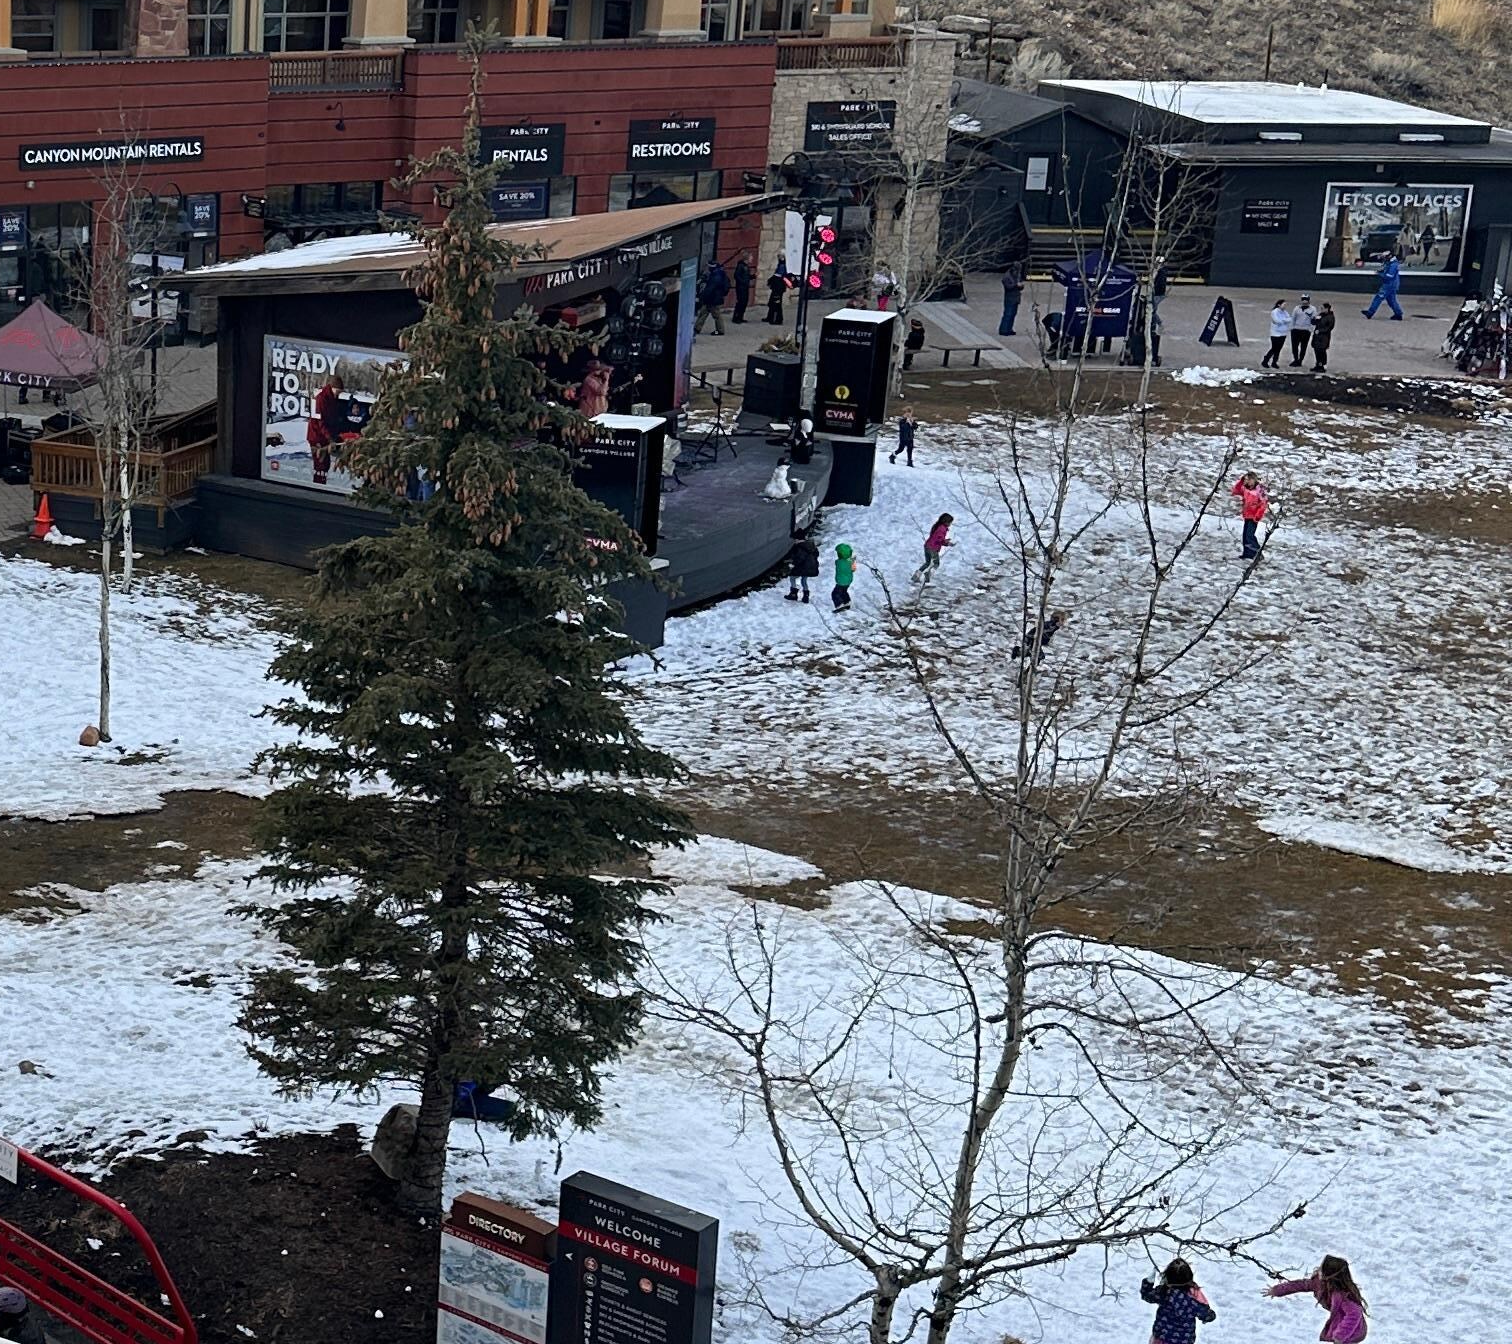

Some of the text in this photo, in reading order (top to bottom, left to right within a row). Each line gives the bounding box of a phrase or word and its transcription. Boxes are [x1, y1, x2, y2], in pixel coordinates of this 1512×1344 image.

[24, 141, 202, 164] CANYON MOUNTAIN RENTALS
[631, 142, 711, 157] RESTROOMS
[498, 191, 535, 201] SAVE 20%
[1334, 192, 1463, 208] LET'S GO PLACES
[2, 217, 20, 226] SAVE
[194, 212, 210, 220] 20%
[2, 225, 20, 233] 20%
[271, 347, 341, 376] READY
[17, 373, 53, 387] CITY
[271, 371, 300, 394] TO
[270, 392, 322, 420] ROLL
[825, 409, 854, 420] CVMA
[588, 1199, 625, 1216] PARK CITY
[468, 1214, 526, 1244] DIRECTORY
[594, 1216, 662, 1249] WELCOME
[574, 1227, 629, 1257] VILLAGE
[633, 1249, 680, 1276] FORUM
